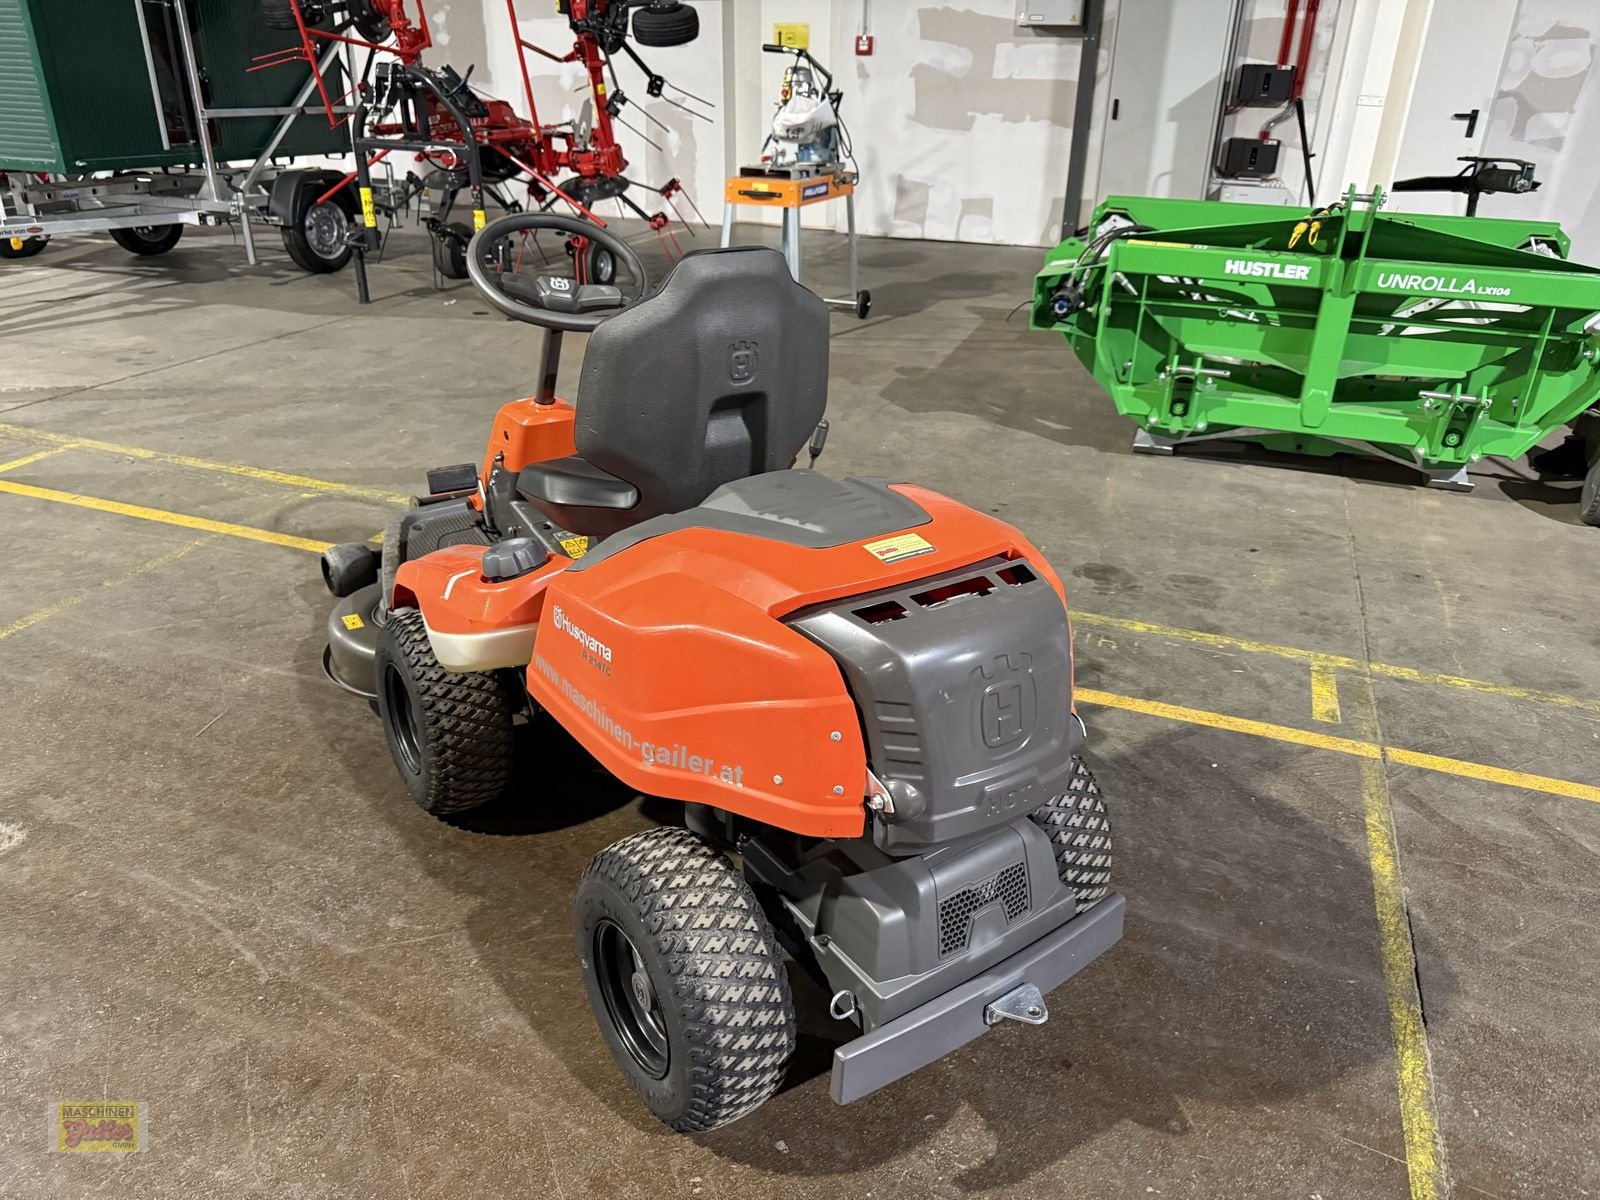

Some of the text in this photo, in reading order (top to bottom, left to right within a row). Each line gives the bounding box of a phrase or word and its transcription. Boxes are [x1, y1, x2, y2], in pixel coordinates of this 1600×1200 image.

[1224, 259, 1310, 281] HUSTLER
[1377, 272, 1512, 297] UNROLLA LX104
[562, 613, 613, 663] Husqvarna
[534, 654, 745, 789] www.maschinen-gailer.at
